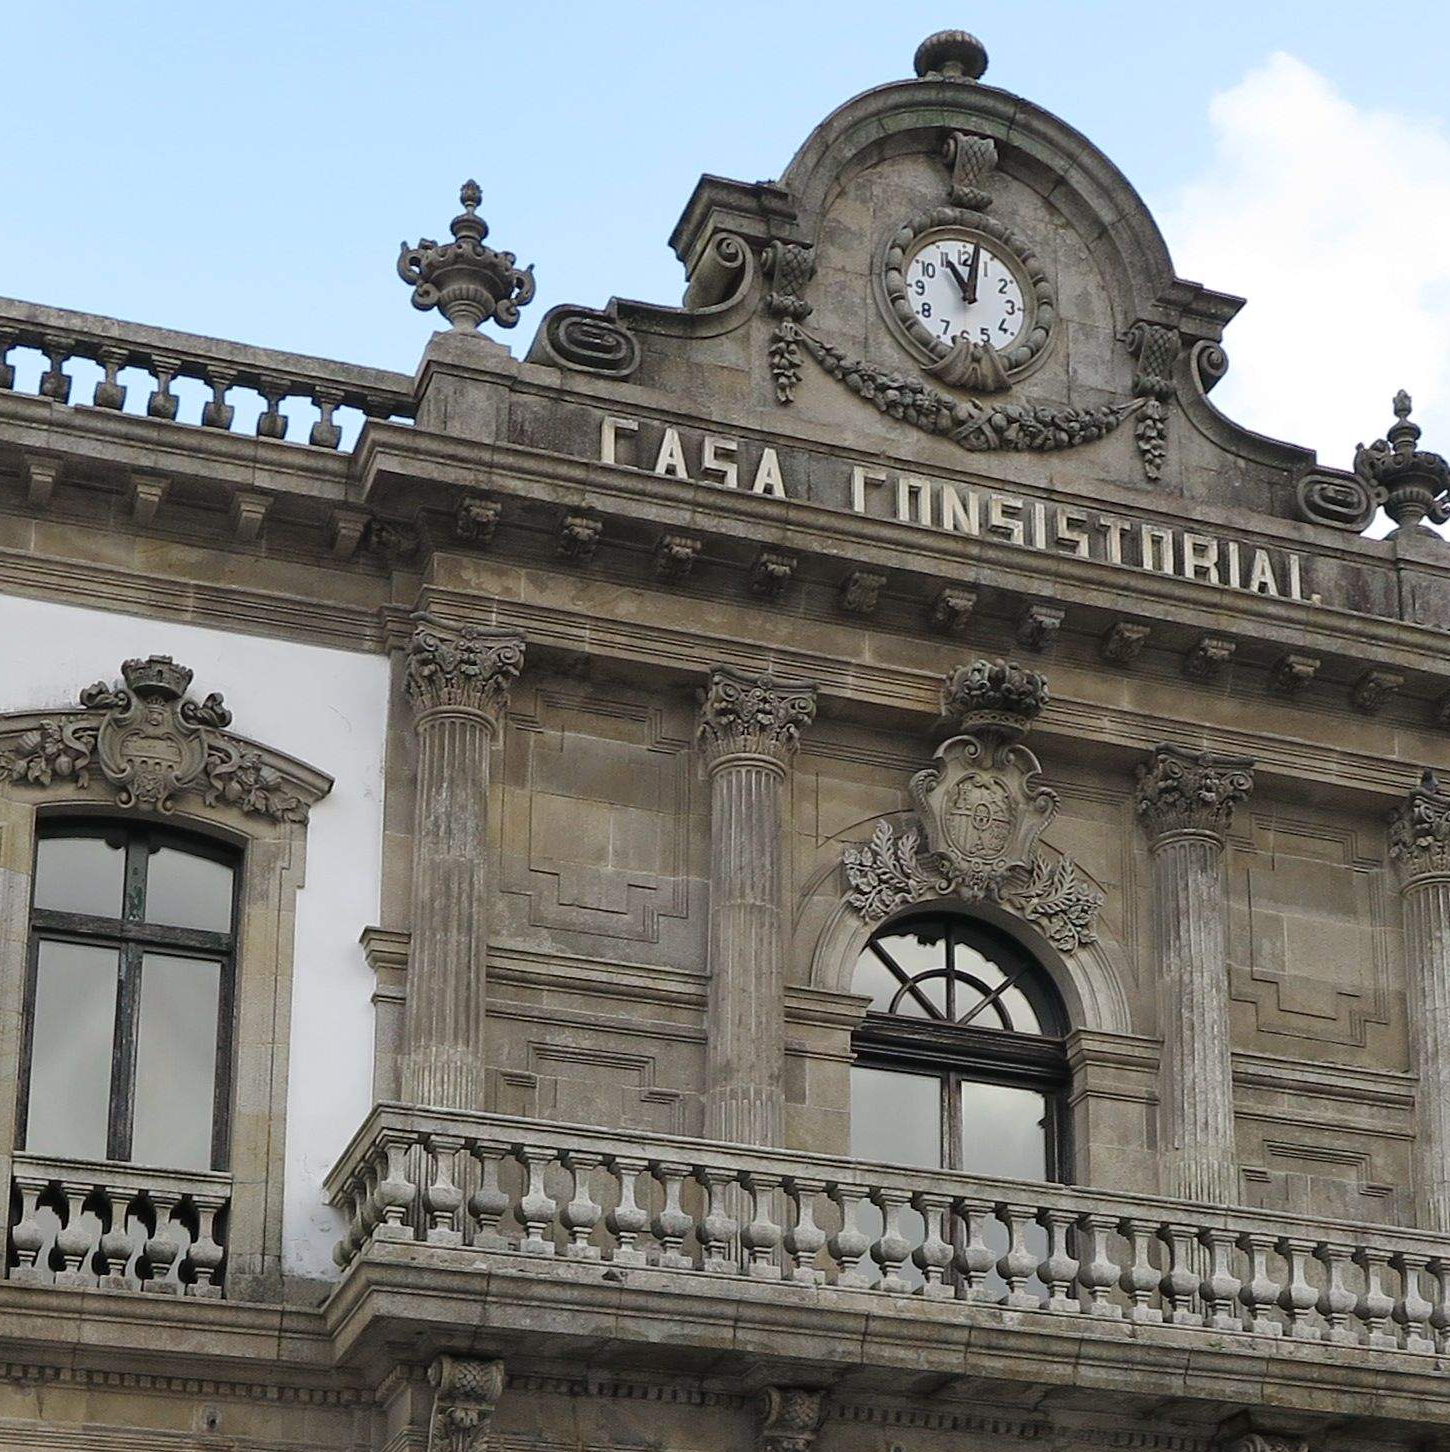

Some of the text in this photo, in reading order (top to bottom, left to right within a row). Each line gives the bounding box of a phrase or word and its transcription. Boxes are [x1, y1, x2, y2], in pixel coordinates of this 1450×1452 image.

[957, 250, 973, 267] 12
[922, 261, 936, 279] 10
[983, 261, 988, 277] 1
[915, 279, 926, 296] 9
[997, 278, 1008, 295] 2
[921, 302, 932, 318] 8
[1005, 299, 1016, 316] 3
[940, 319, 951, 335] 7
[980, 327, 991, 343] 5
[998, 318, 1008, 335] 4
[600, 415, 1322, 606] CASA CONSISTORIAL
